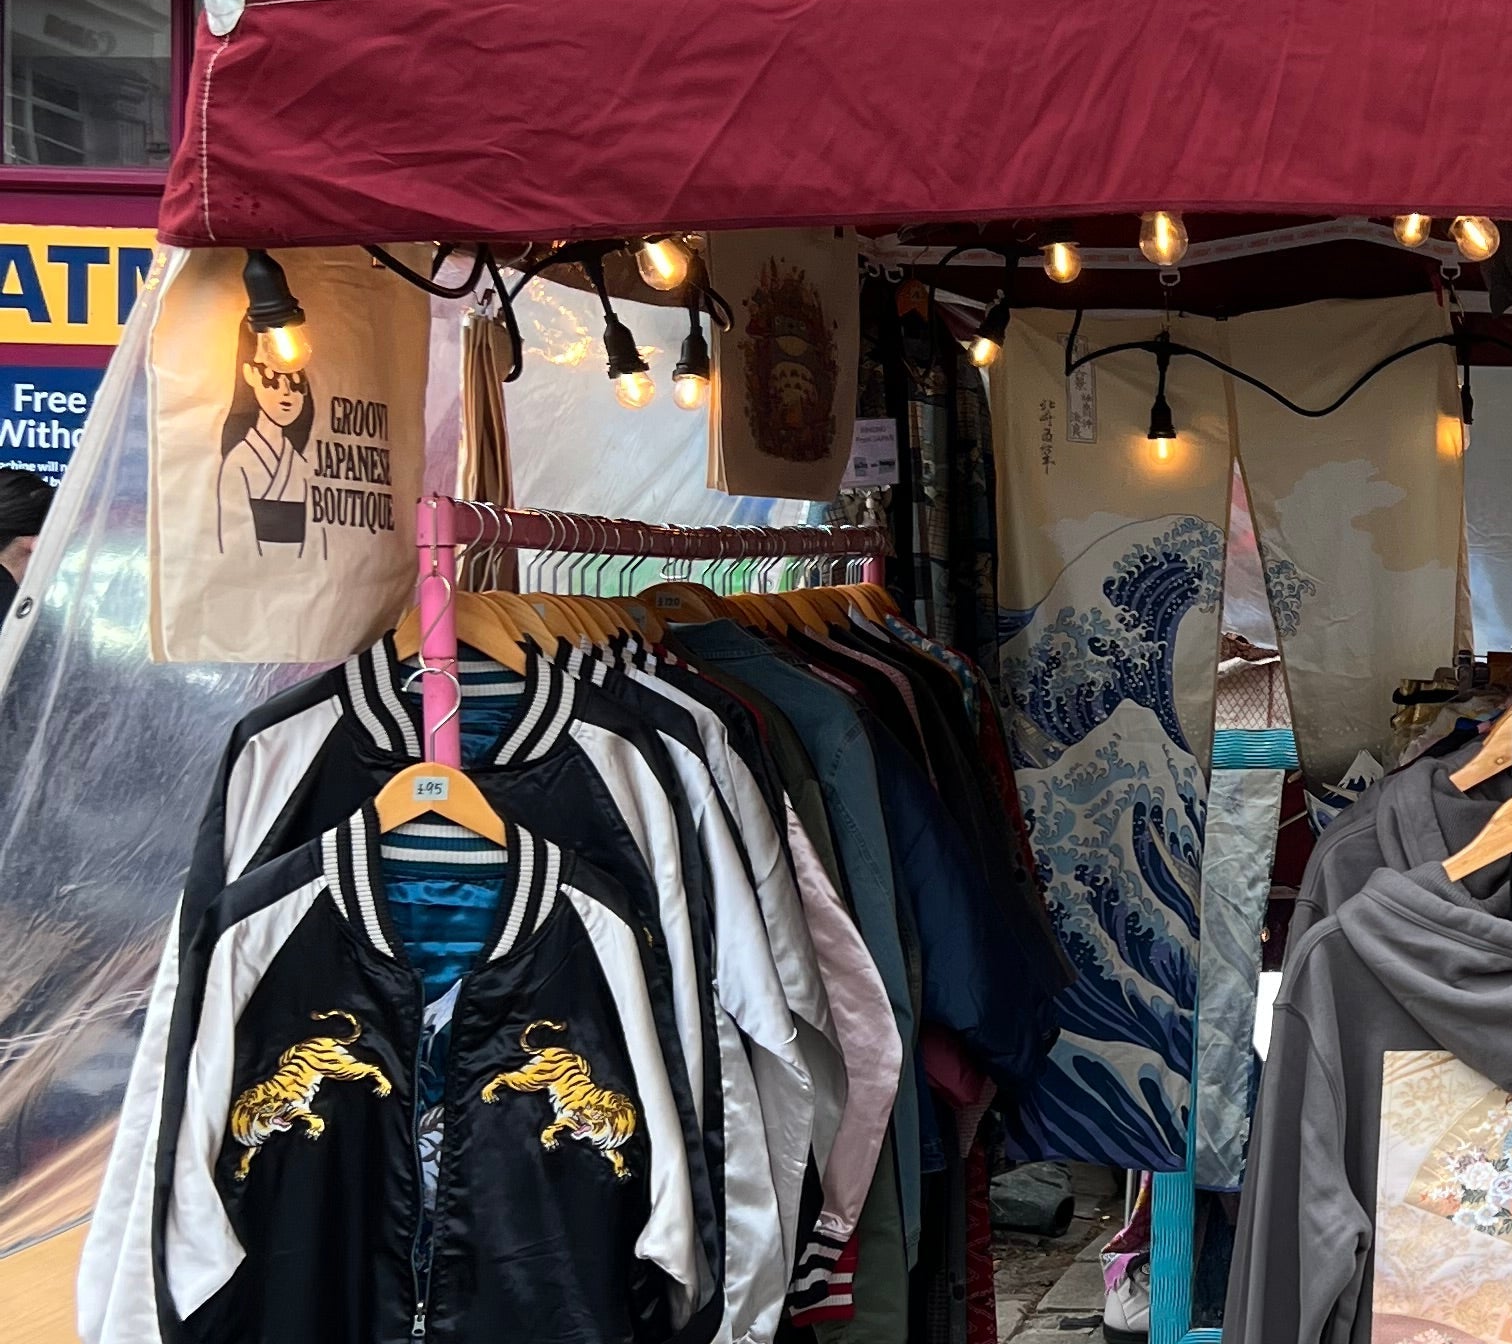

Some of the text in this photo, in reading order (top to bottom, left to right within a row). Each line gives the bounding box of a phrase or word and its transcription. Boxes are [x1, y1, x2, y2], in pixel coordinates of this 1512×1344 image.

[14, 383, 87, 414] Free
[314, 439, 393, 487] JAPANESE
[311, 485, 395, 535] BOUTIQUE
[417, 781, 444, 796] £95
